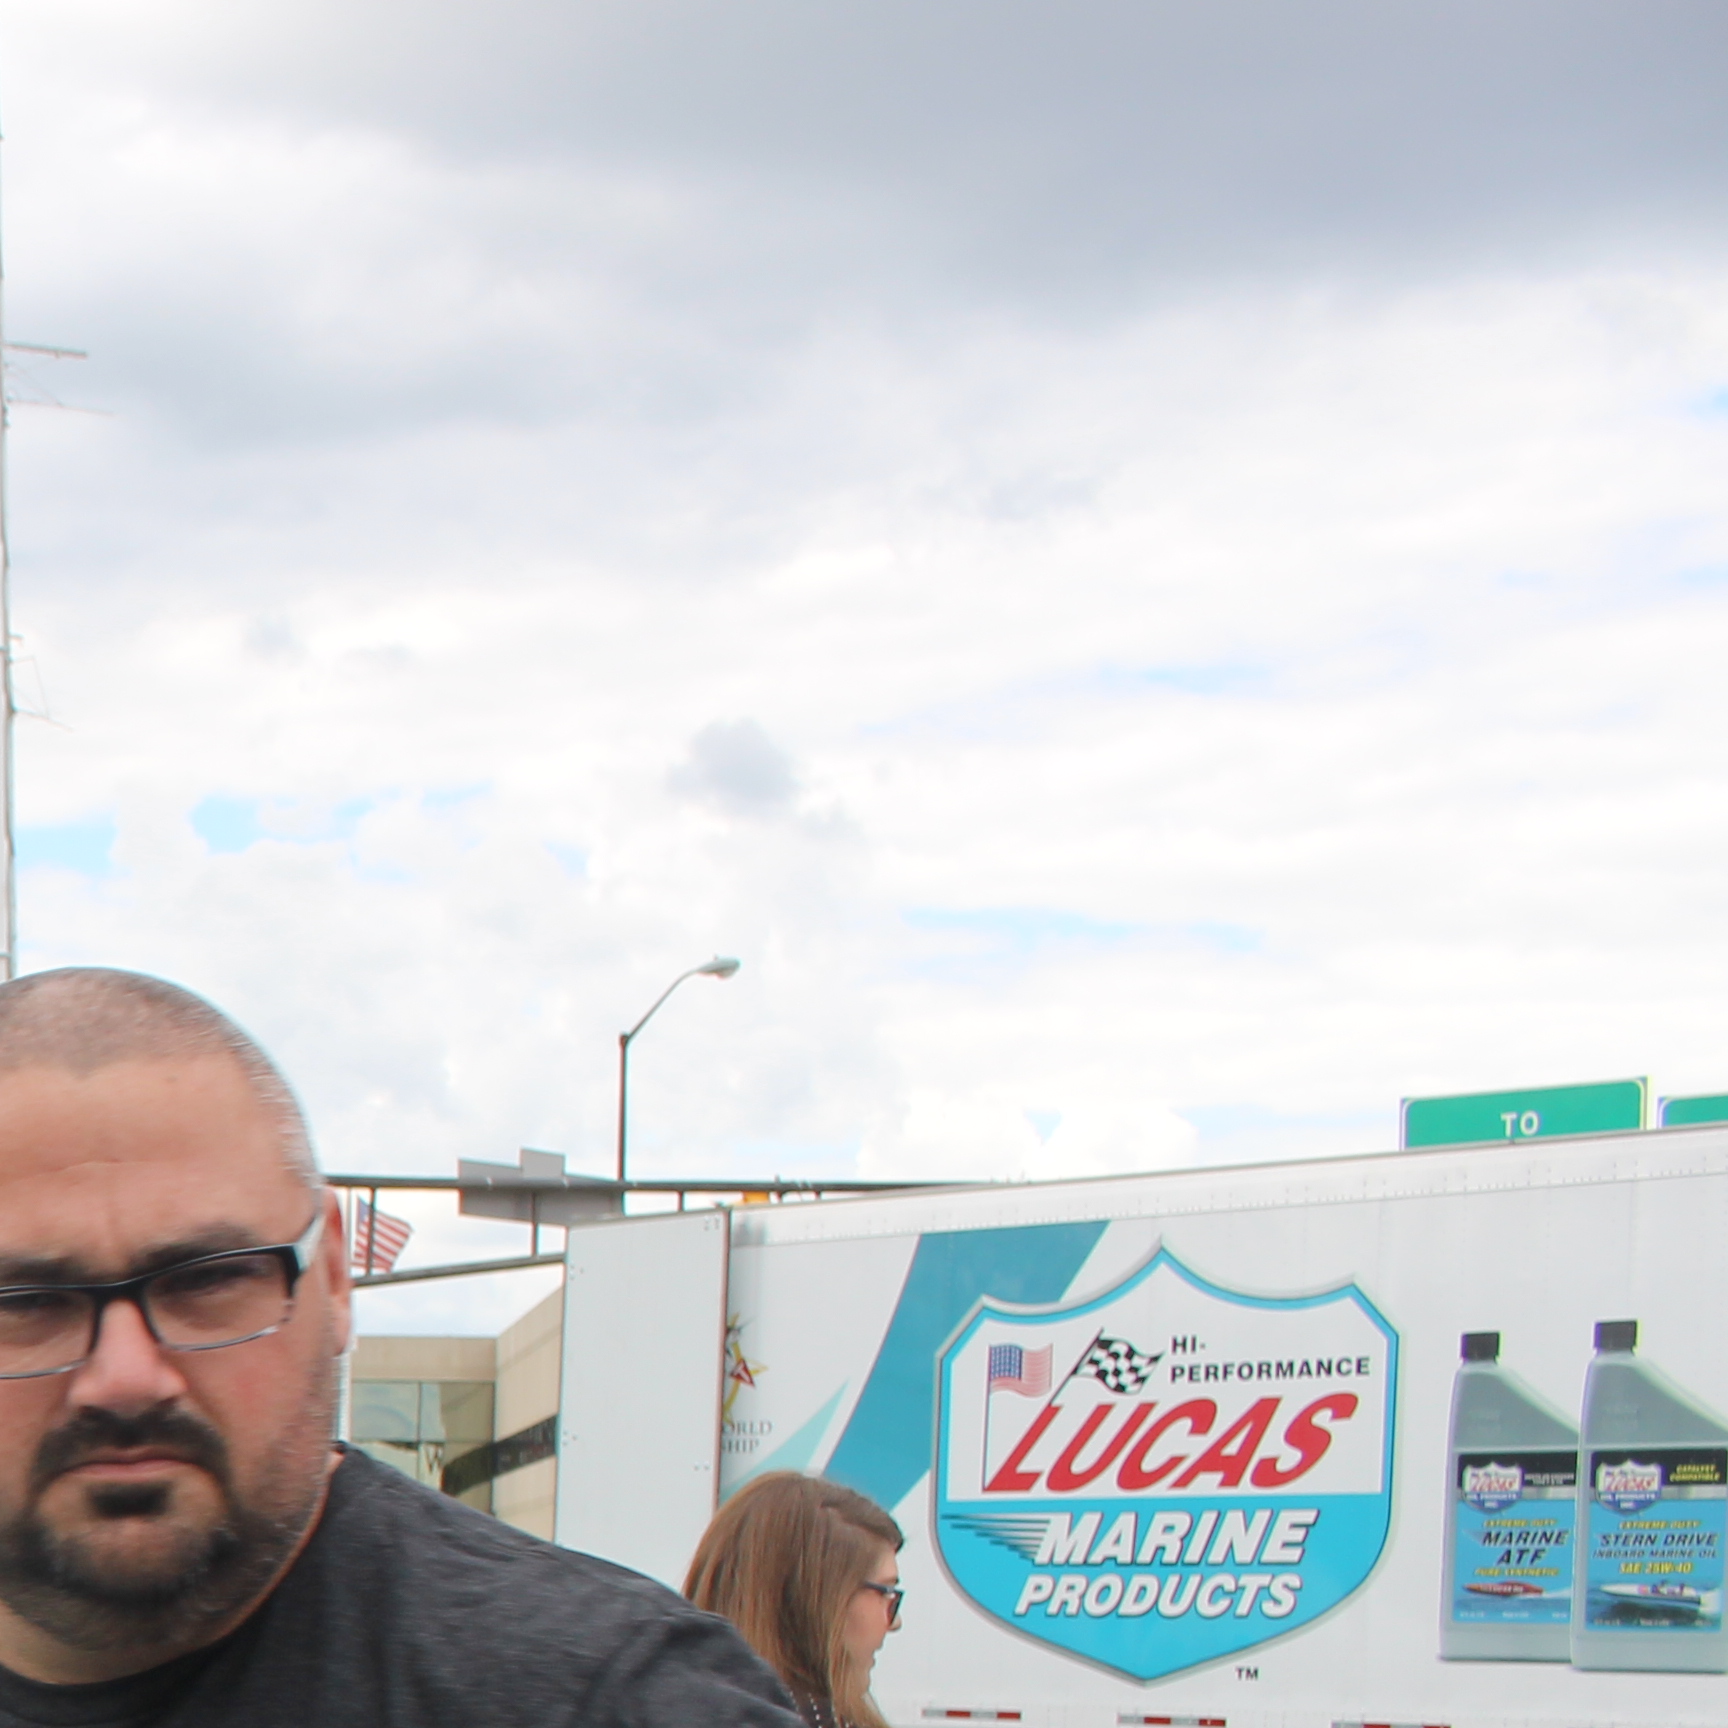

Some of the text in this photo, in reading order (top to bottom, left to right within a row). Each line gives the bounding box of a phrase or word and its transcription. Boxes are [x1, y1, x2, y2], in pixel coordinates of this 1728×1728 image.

[1501, 1112, 1540, 1137] TO
[1170, 1335, 1206, 1355] HI-
[1170, 1356, 1371, 1384] PERFORMANCE
[982, 1391, 1360, 1494] LUCAS
[1032, 1508, 1321, 1568] MARINE
[1482, 1530, 1570, 1547] MARINE
[1600, 1533, 1719, 1547] STERN DRIVE
[1497, 1549, 1547, 1566] ATF
[1648, 1549, 1695, 1559] MARINE
[1698, 1549, 1718, 1559] OIL
[1013, 1572, 1304, 1619] PRODUCTS
[1236, 1666, 1260, 1681] TM
